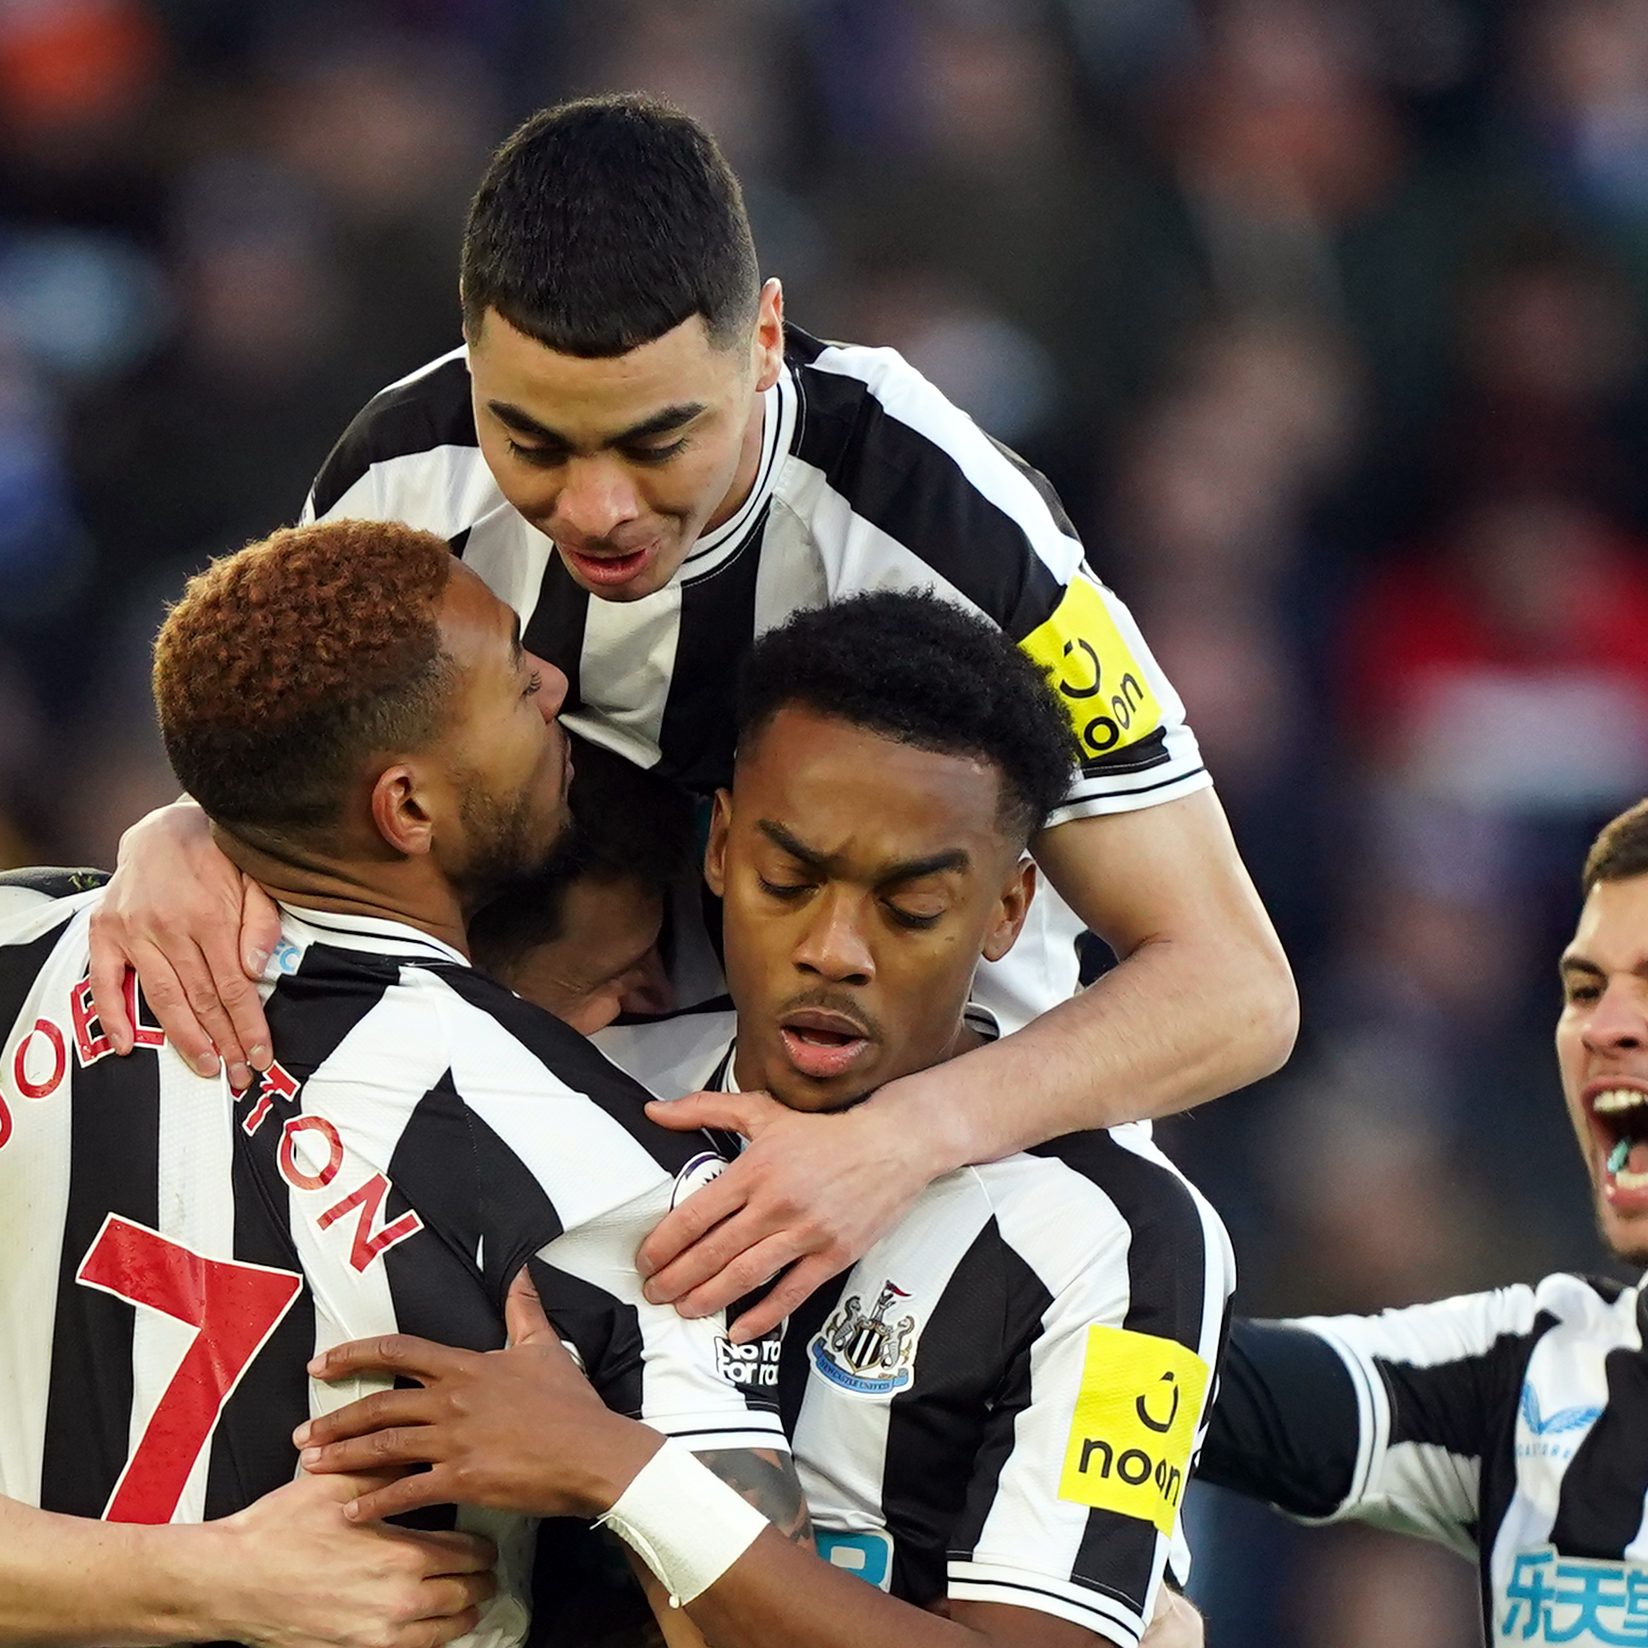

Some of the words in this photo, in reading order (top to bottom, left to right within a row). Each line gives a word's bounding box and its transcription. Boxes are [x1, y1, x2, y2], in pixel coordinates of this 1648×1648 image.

[1084, 673, 1144, 751] oon
[75, 1211, 303, 1525] 7
[1078, 1437, 1181, 1507] noon
